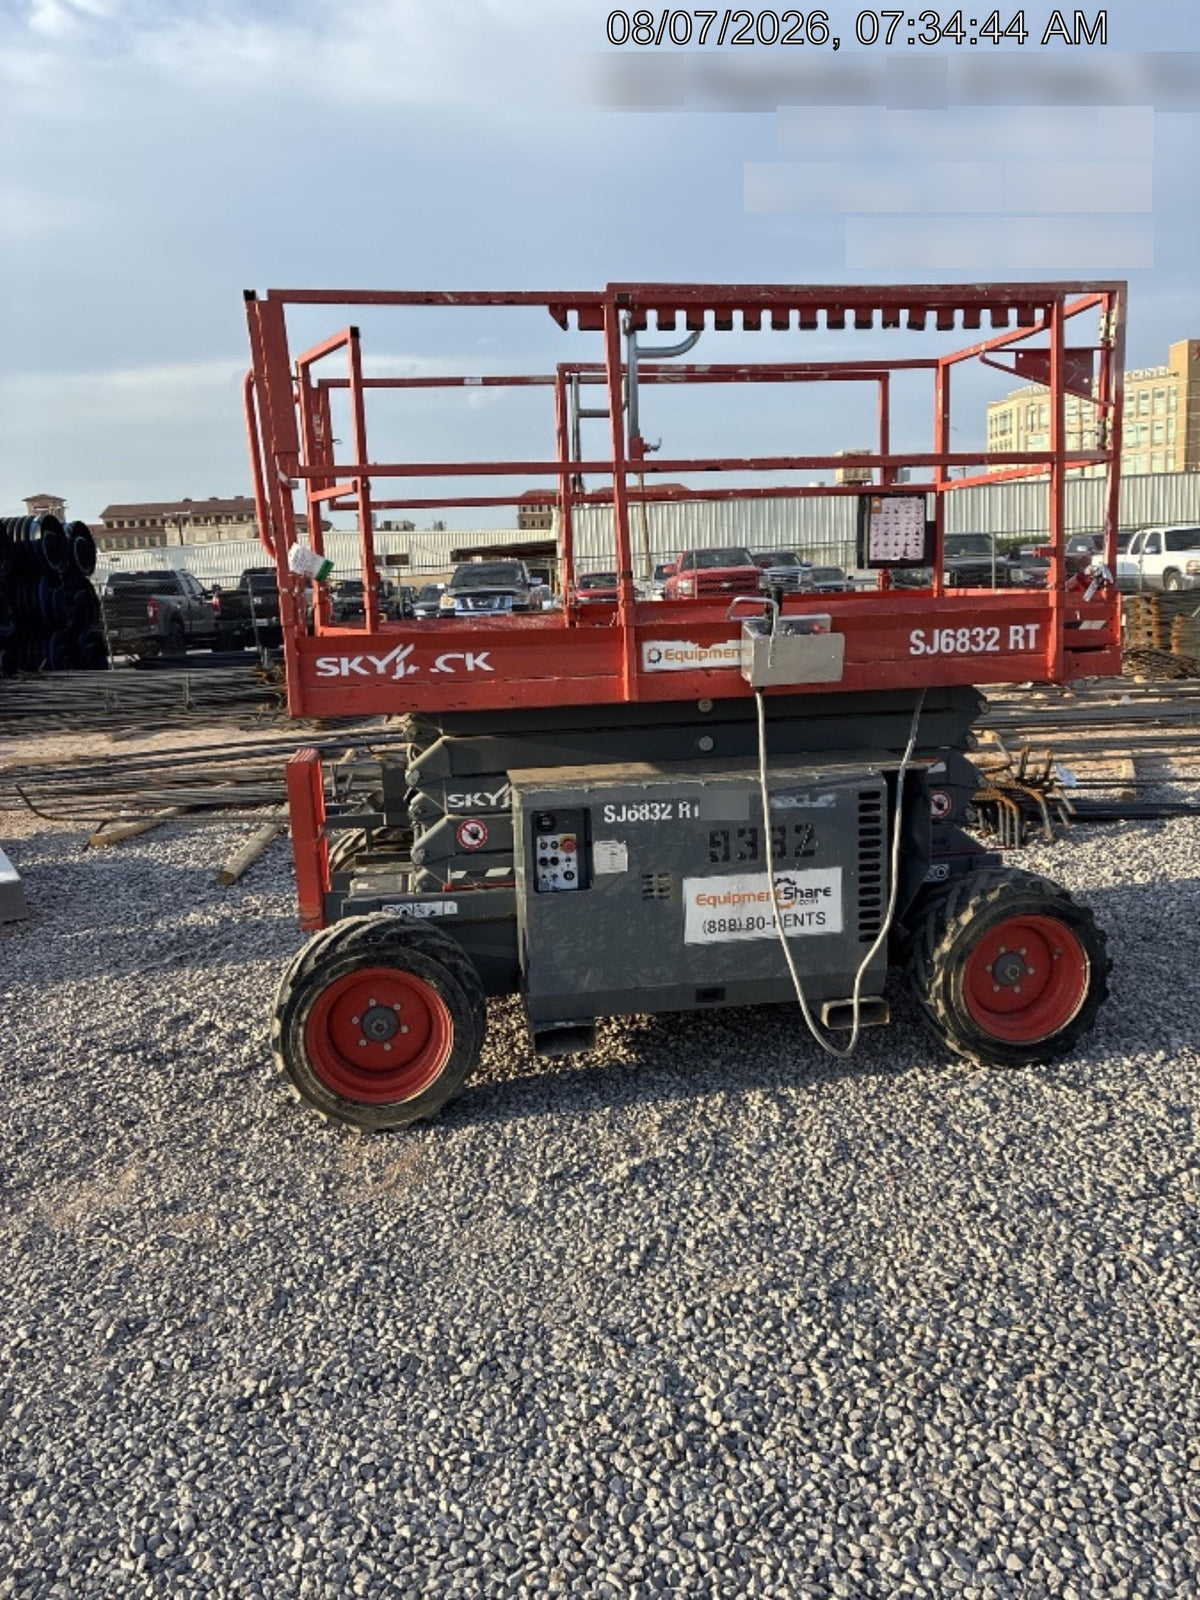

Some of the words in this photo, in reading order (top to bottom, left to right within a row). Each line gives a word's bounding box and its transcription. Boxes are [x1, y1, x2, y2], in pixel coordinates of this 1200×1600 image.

[909, 627, 1000, 655] SJ6832
[1009, 624, 1040, 650] RT
[316, 643, 495, 680] SKYJCK
[448, 782, 512, 808] SKYJ
[603, 803, 673, 823] SJ6832
